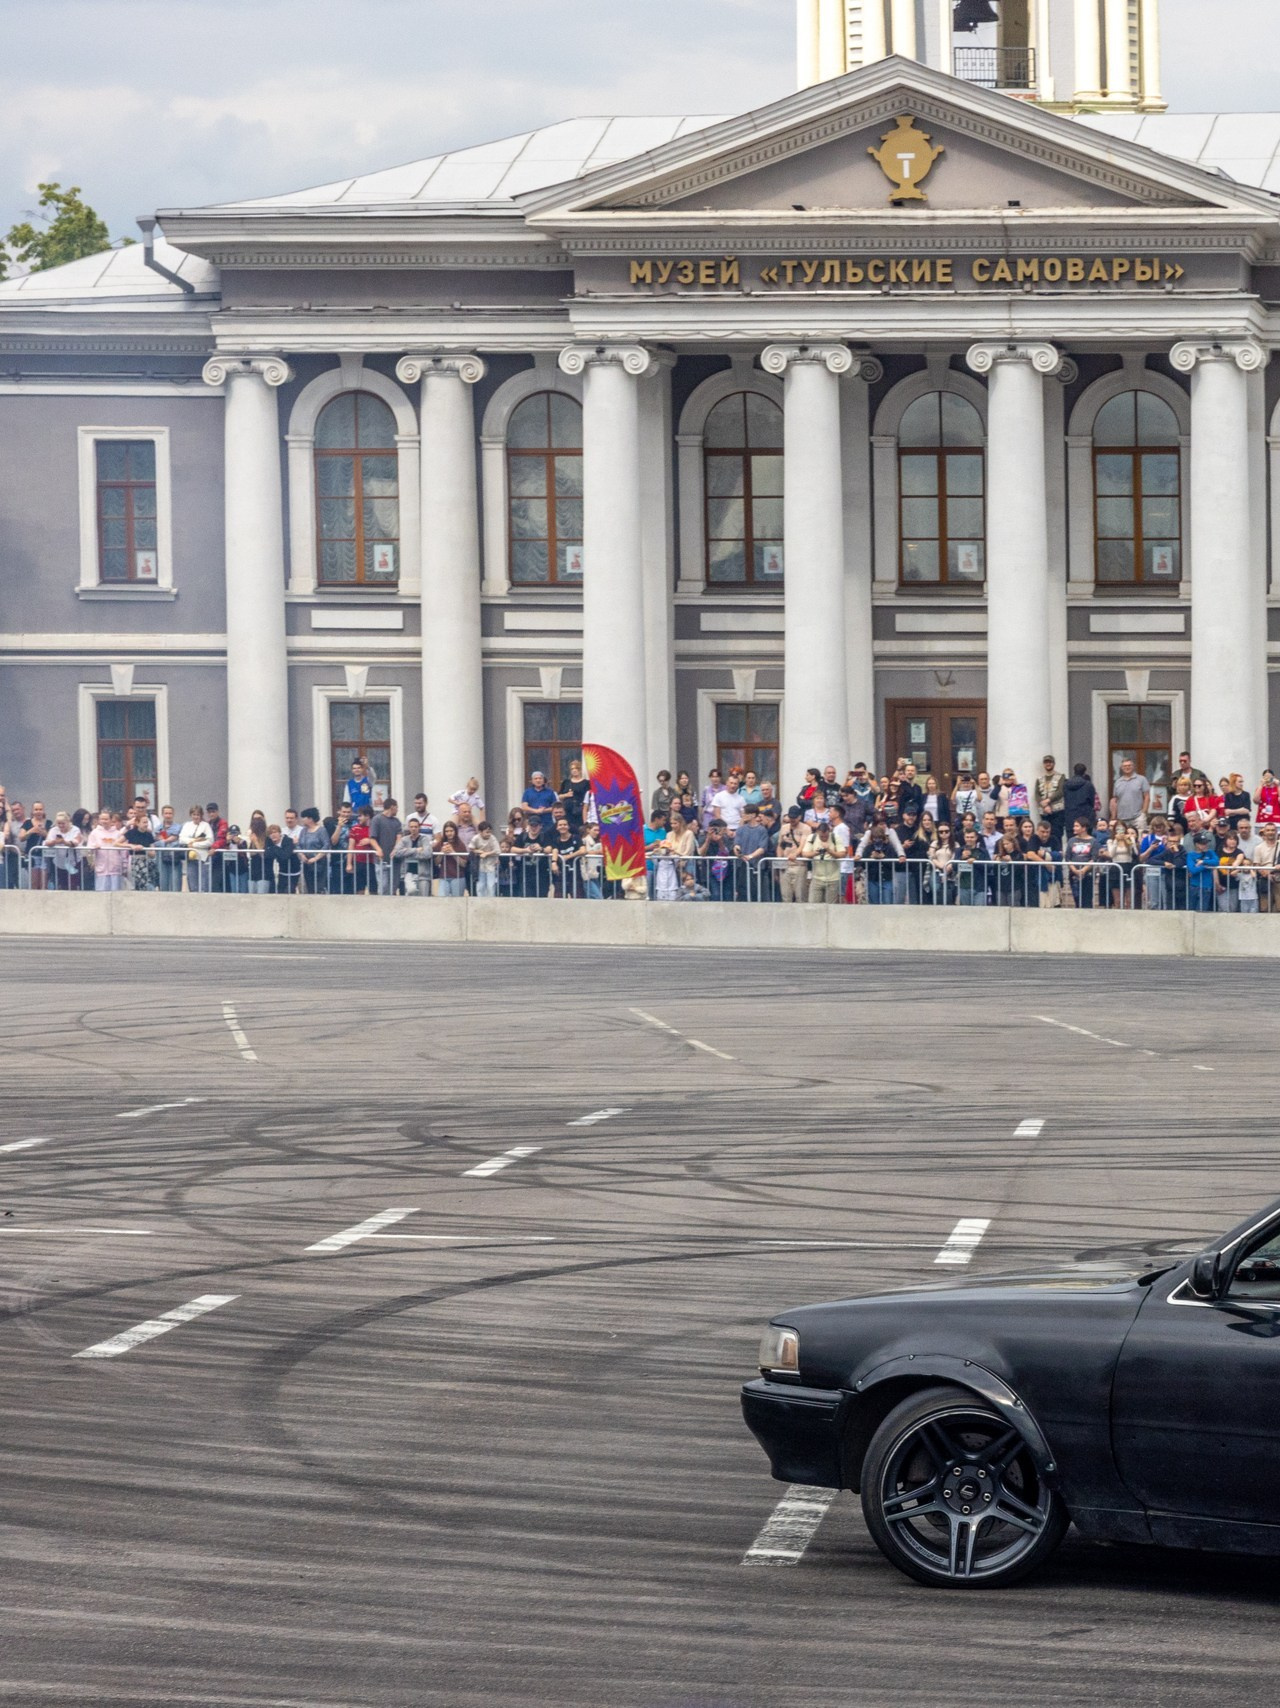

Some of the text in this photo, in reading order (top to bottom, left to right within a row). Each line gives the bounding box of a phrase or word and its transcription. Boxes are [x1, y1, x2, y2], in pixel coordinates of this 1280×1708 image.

[629, 255, 1185, 285] МУЗЕЙ «ТУЛЬСКИЕ САМОВАРЫ»
